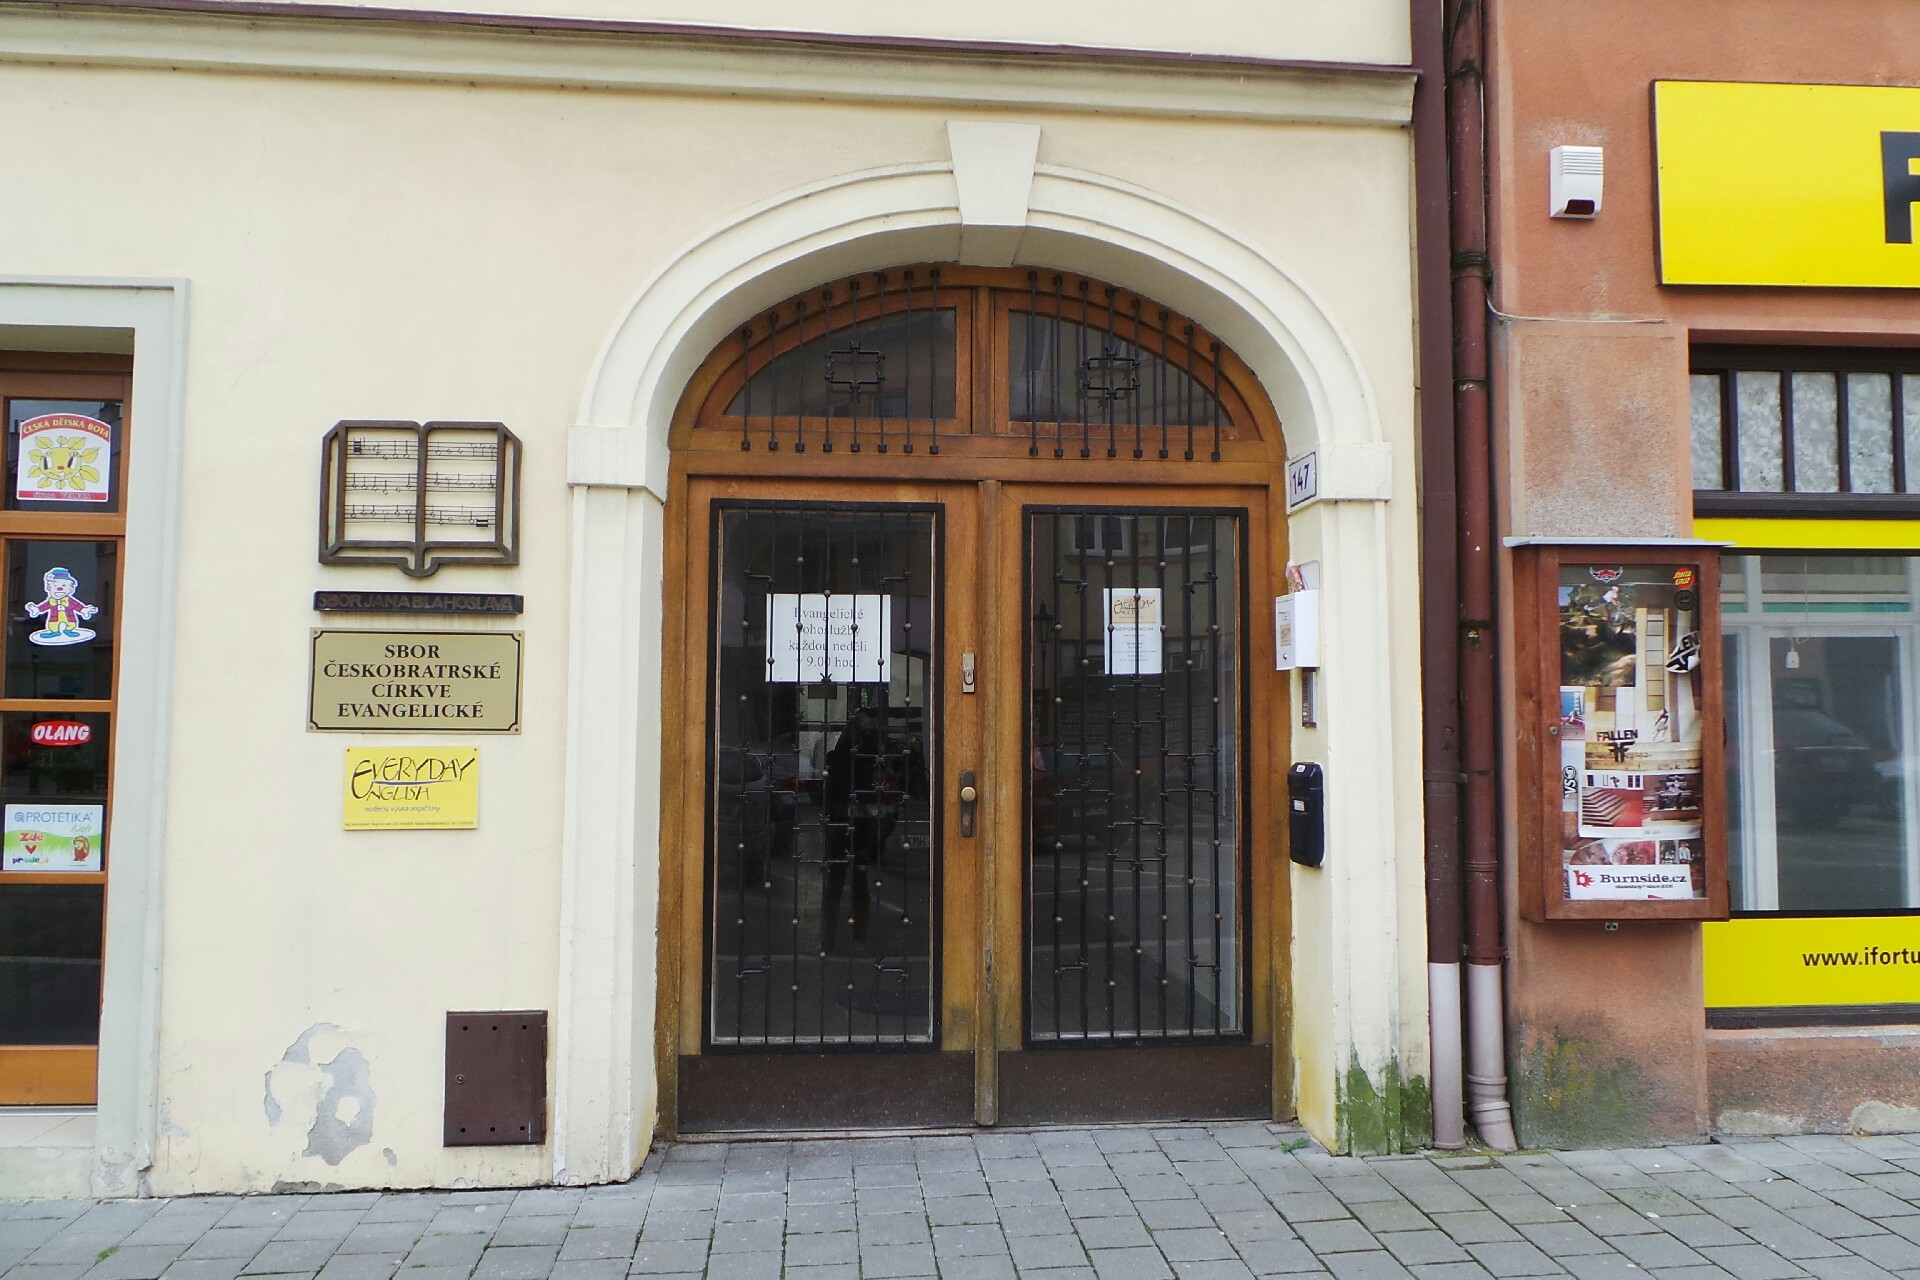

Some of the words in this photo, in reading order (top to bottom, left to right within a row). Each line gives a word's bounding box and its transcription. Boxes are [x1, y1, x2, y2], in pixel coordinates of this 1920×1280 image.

[52, 418, 85, 428] DĚTSKÁ
[87, 423, 109, 438] BOTA
[1293, 463, 1310, 495] 147
[319, 594, 362, 608] SBOR
[364, 595, 411, 608] JANA
[412, 596, 513, 611] BLAHOSLAVA
[797, 624, 860, 637] oholužby
[385, 644, 440, 659] SBOR
[833, 640, 867, 651] neděli
[323, 660, 501, 679] ČESKOBRATRSKÉ
[372, 680, 451, 698] CÍRKVE
[337, 701, 483, 718] EVANGELICKÉ
[34, 725, 90, 740] OLANG
[1597, 729, 1638, 741] FALLEN
[26, 811, 92, 823] PROTETIKA
[19, 832, 43, 842] Zde
[1600, 873, 1686, 883] Burnside.cz
